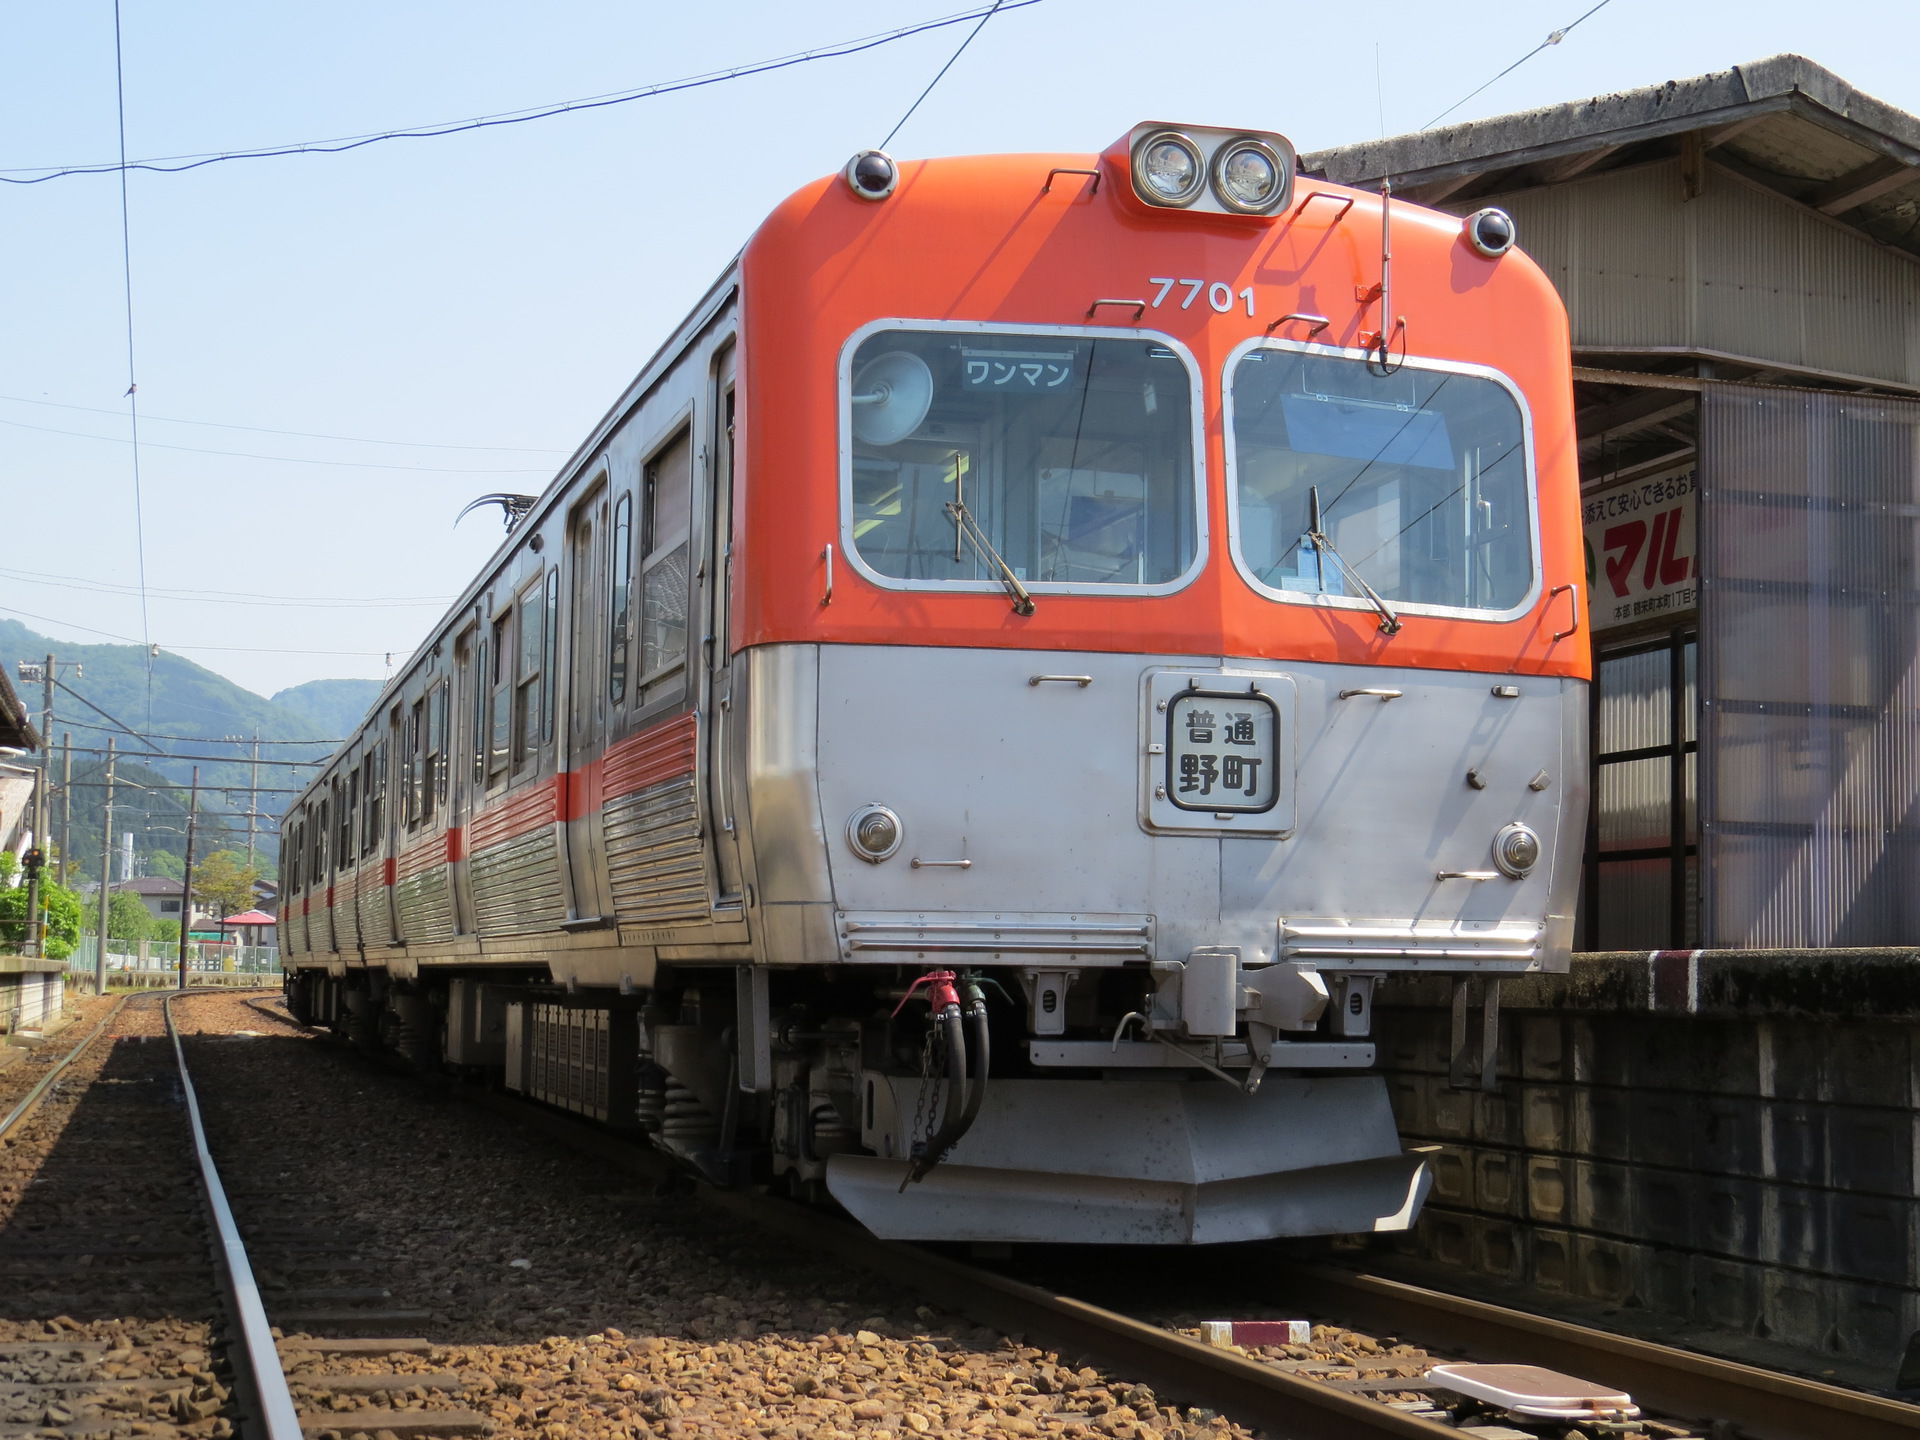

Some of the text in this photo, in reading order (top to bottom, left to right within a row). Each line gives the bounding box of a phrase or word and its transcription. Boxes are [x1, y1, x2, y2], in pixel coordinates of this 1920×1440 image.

[1149, 277, 1256, 316] 7701
[967, 361, 1070, 386] ワンマン
[1582, 470, 1697, 525] 添えて安心できるお買
[1603, 506, 1697, 598] マル
[1186, 709, 1256, 745] 普通
[1179, 754, 1262, 796] 野町
